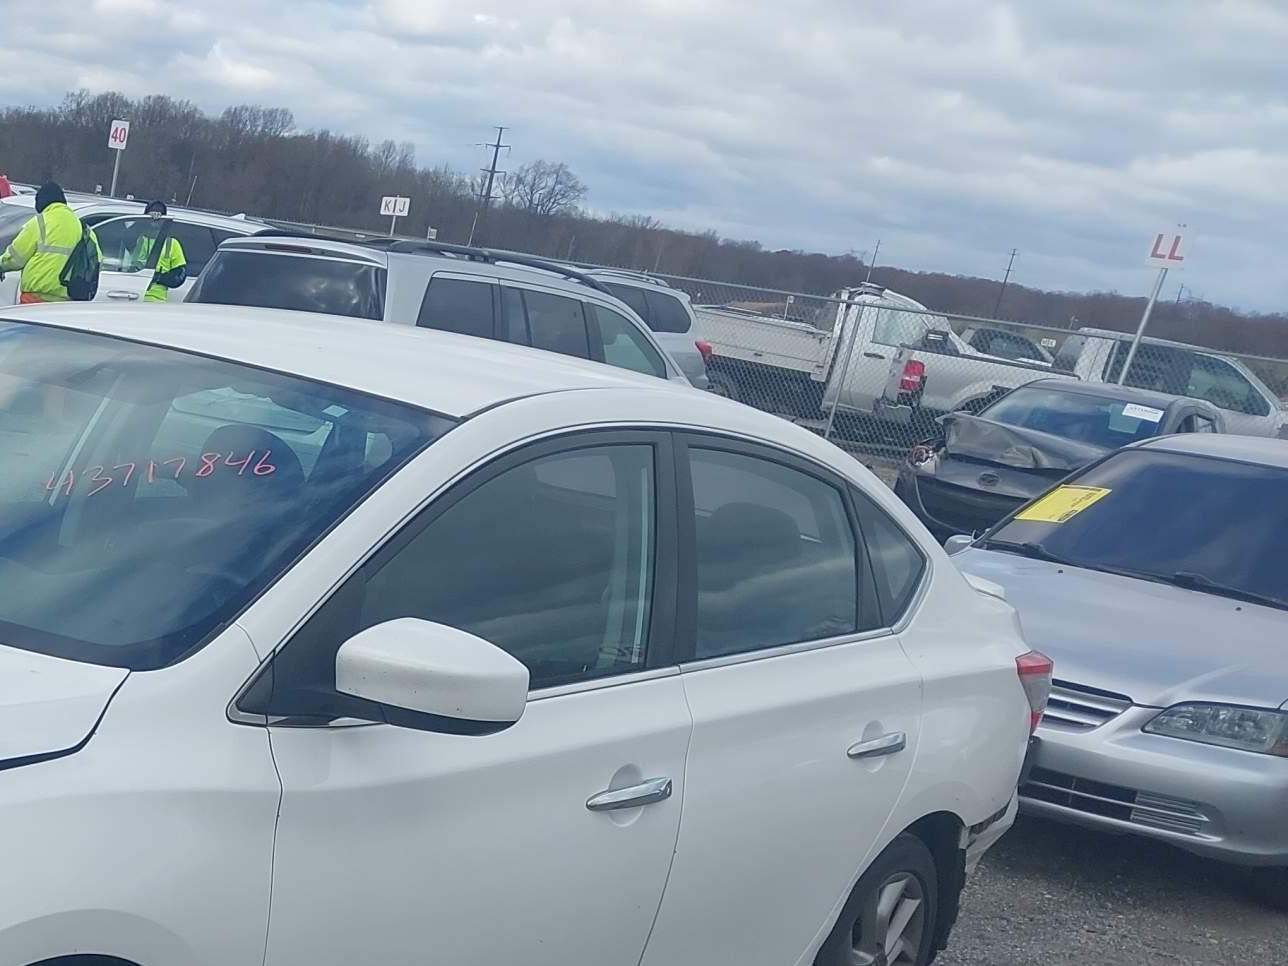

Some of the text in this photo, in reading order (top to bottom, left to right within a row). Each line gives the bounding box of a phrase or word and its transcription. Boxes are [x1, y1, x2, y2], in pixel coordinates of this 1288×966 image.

[112, 127, 127, 143] 40
[1151, 233, 1184, 260] LL
[45, 450, 277, 497] 43717846
